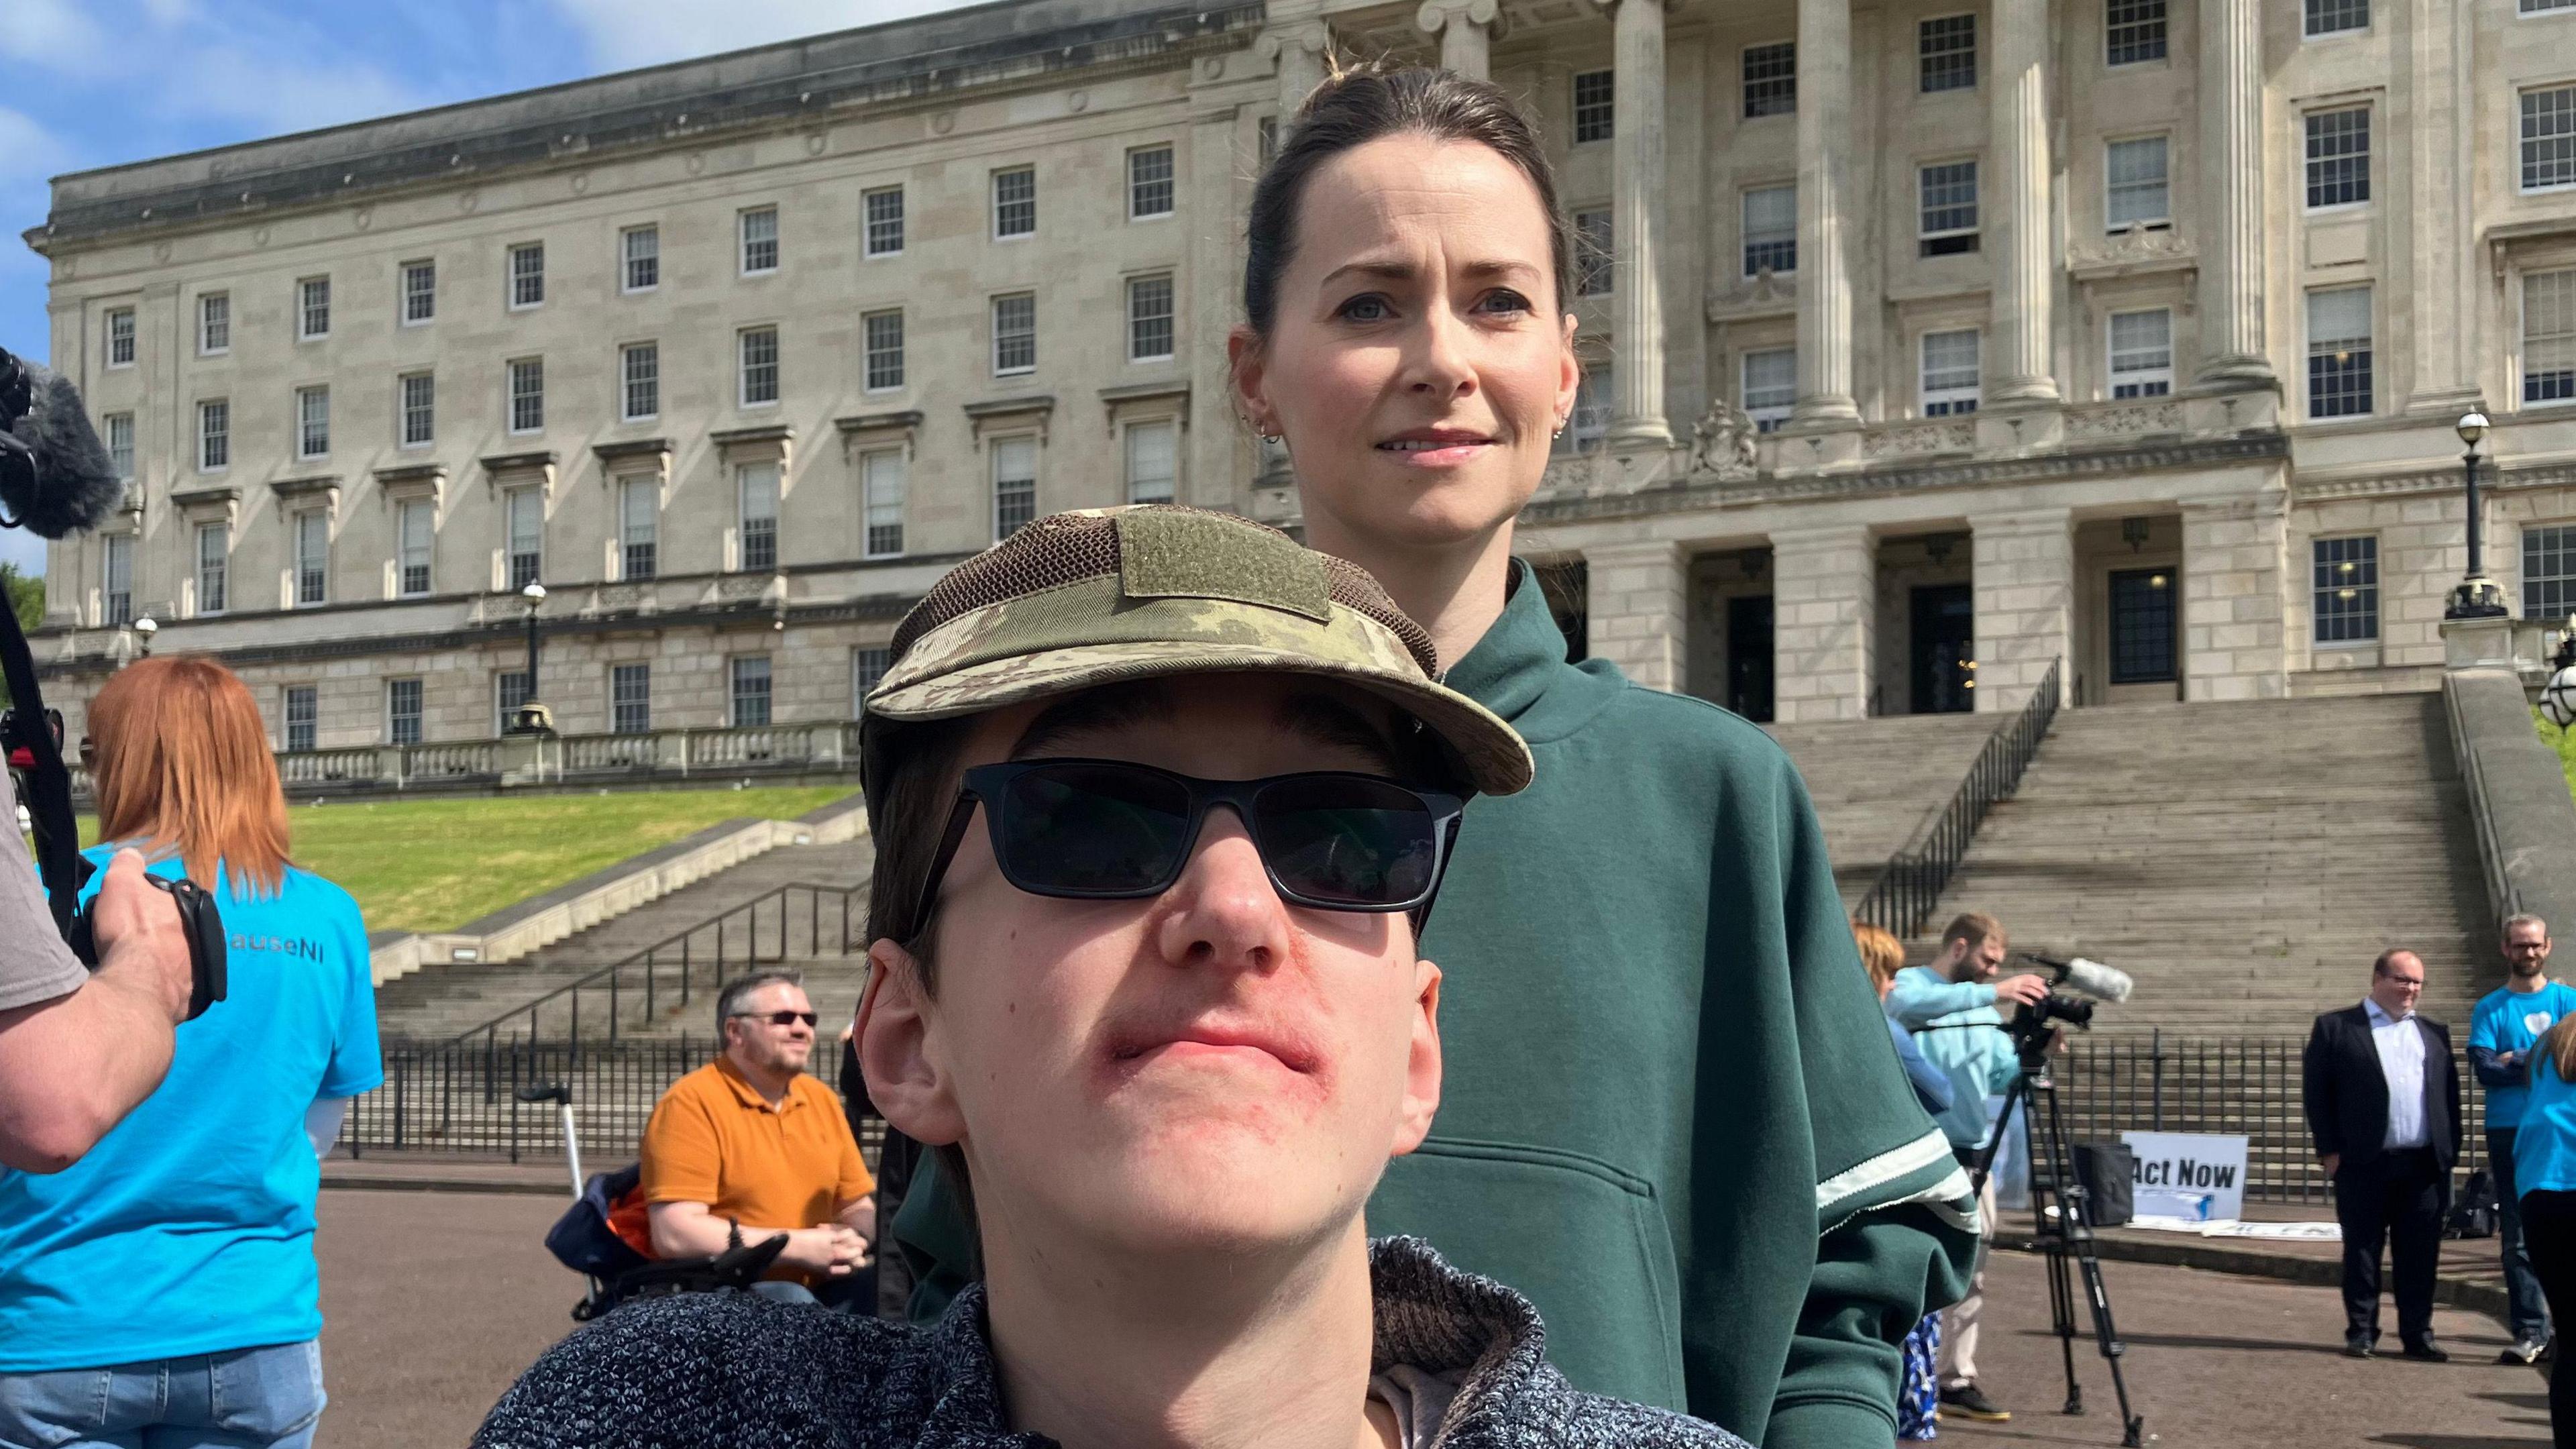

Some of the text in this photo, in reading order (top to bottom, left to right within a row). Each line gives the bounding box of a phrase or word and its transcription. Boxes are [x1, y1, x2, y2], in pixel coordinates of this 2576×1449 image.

[231, 933, 323, 963] auseNI
[2132, 1157, 2236, 1188] Act Now
